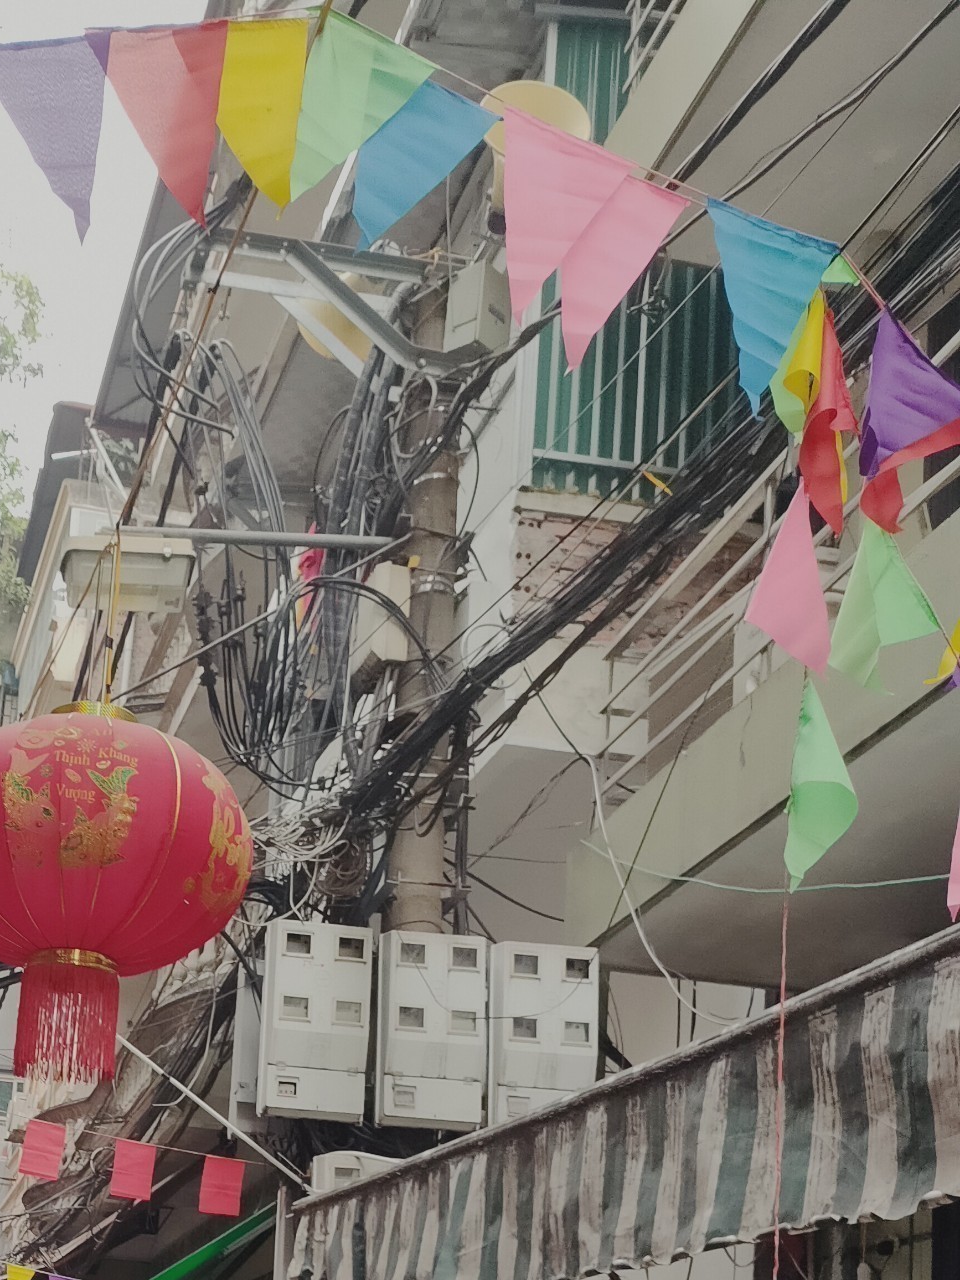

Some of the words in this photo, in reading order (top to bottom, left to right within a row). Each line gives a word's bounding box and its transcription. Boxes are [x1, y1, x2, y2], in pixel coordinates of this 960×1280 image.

[54, 749, 91, 767] Thịnh
[97, 746, 139, 768] Khang
[56, 783, 97, 804] Vượng
